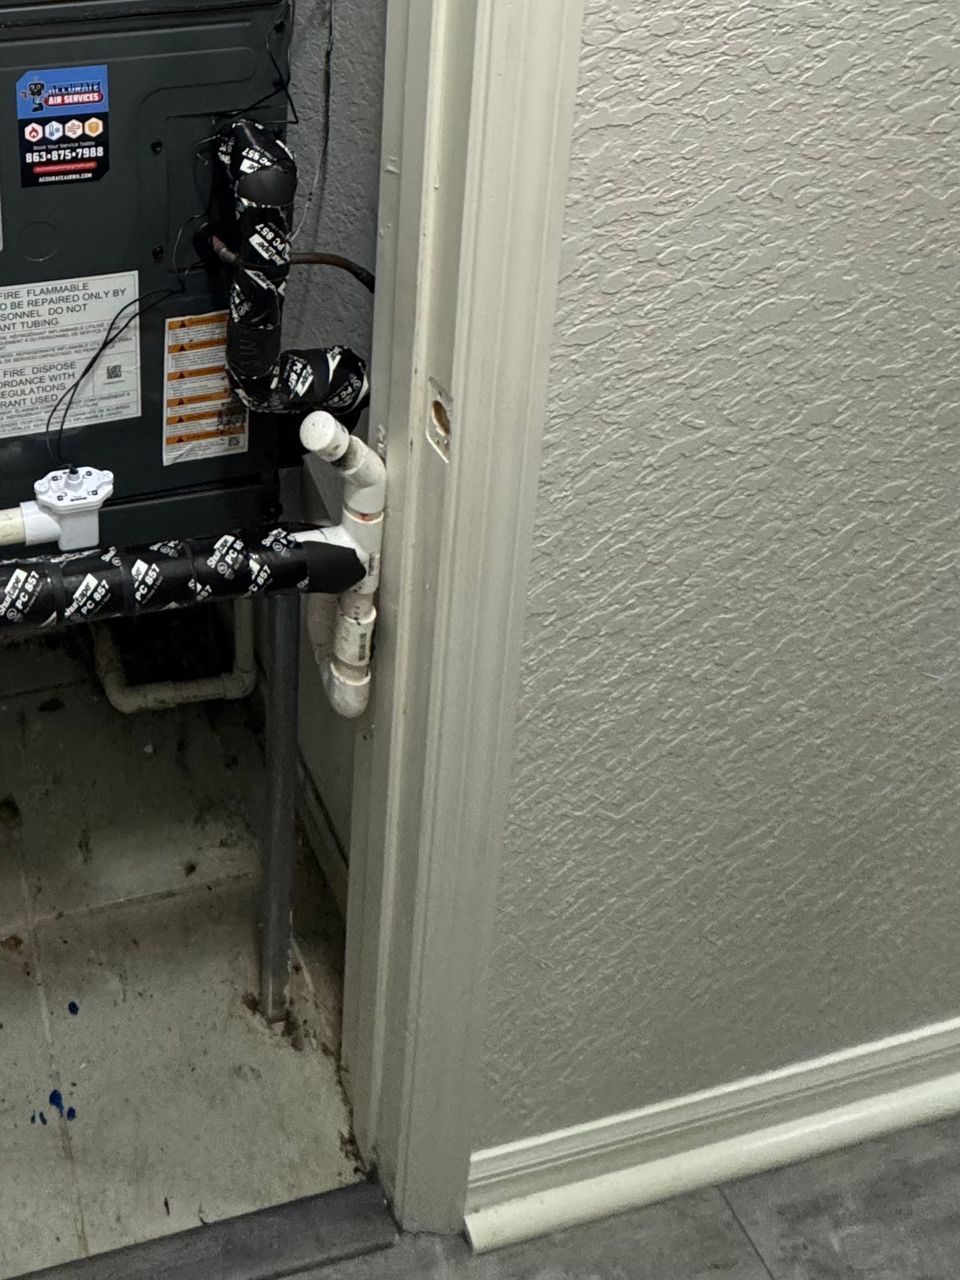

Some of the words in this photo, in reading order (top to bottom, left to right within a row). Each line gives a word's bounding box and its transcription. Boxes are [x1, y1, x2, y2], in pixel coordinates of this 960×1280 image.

[48, 96, 62, 104] AIR
[64, 93, 99, 103] SERVICES
[255, 223, 275, 240] 857
[272, 237, 286, 251] PC
[26, 282, 89, 297] FLAMMABLE
[9, 300, 24, 309] BE
[26, 293, 79, 308] REPAIRED
[82, 290, 109, 301] ONLY
[112, 288, 126, 297] BY
[47, 305, 63, 315] DO
[66, 302, 88, 313] NOT
[31, 361, 76, 374] DISPOSE
[48, 370, 75, 382] WITH
[225, 549, 238, 565] PC
[135, 585, 147, 601] PC
[145, 563, 160, 585] 857
[257, 565, 271, 585] 857
[15, 592, 29, 610] PC
[26, 570, 40, 592] 857
[81, 601, 94, 615] PC
[93, 580, 109, 600] 857
